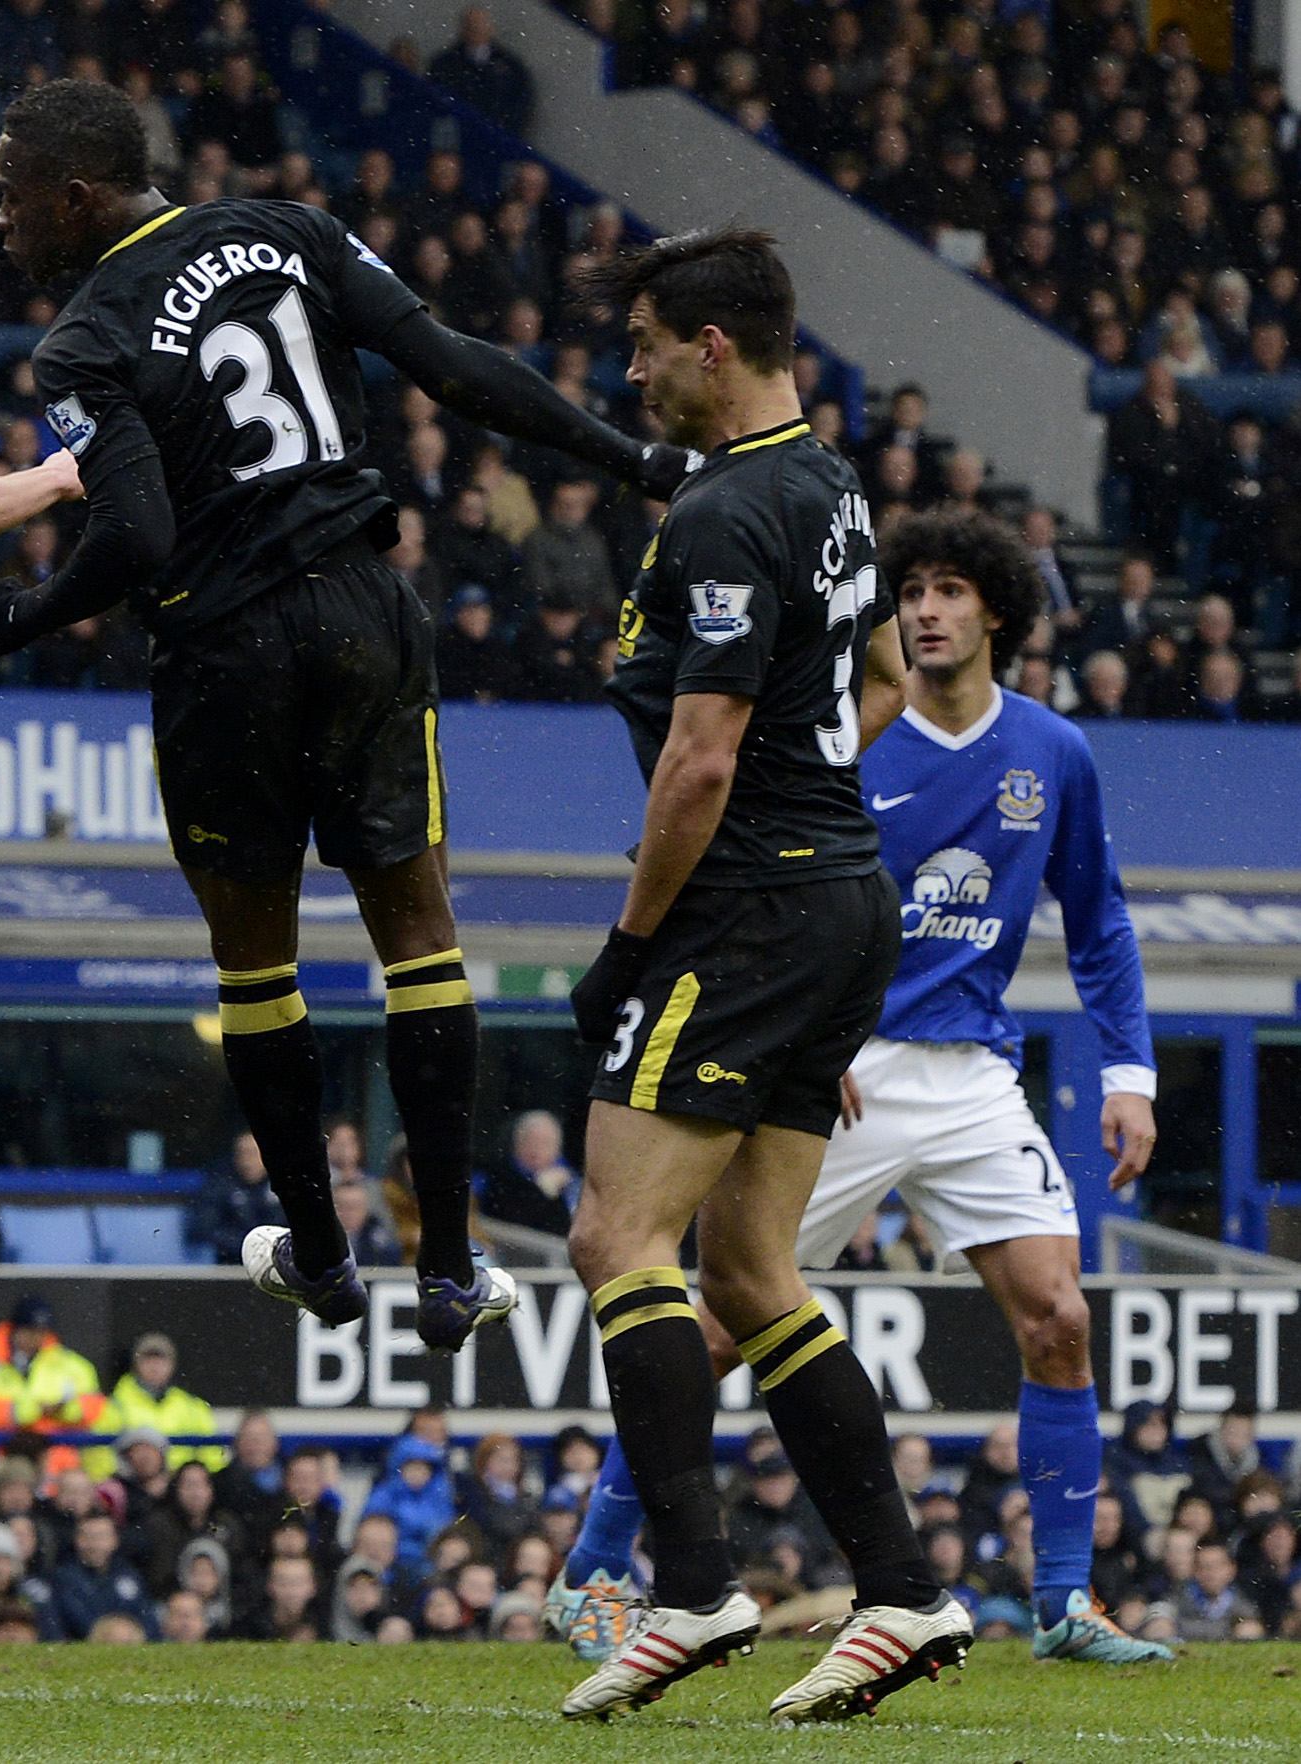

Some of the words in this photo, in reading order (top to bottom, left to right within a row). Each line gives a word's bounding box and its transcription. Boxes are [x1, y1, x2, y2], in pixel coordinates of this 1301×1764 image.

[151, 243, 308, 356] FIGUEROA
[199, 285, 345, 482] 31
[901, 903, 1004, 950] Chang
[1110, 1288, 1300, 1413] BET
